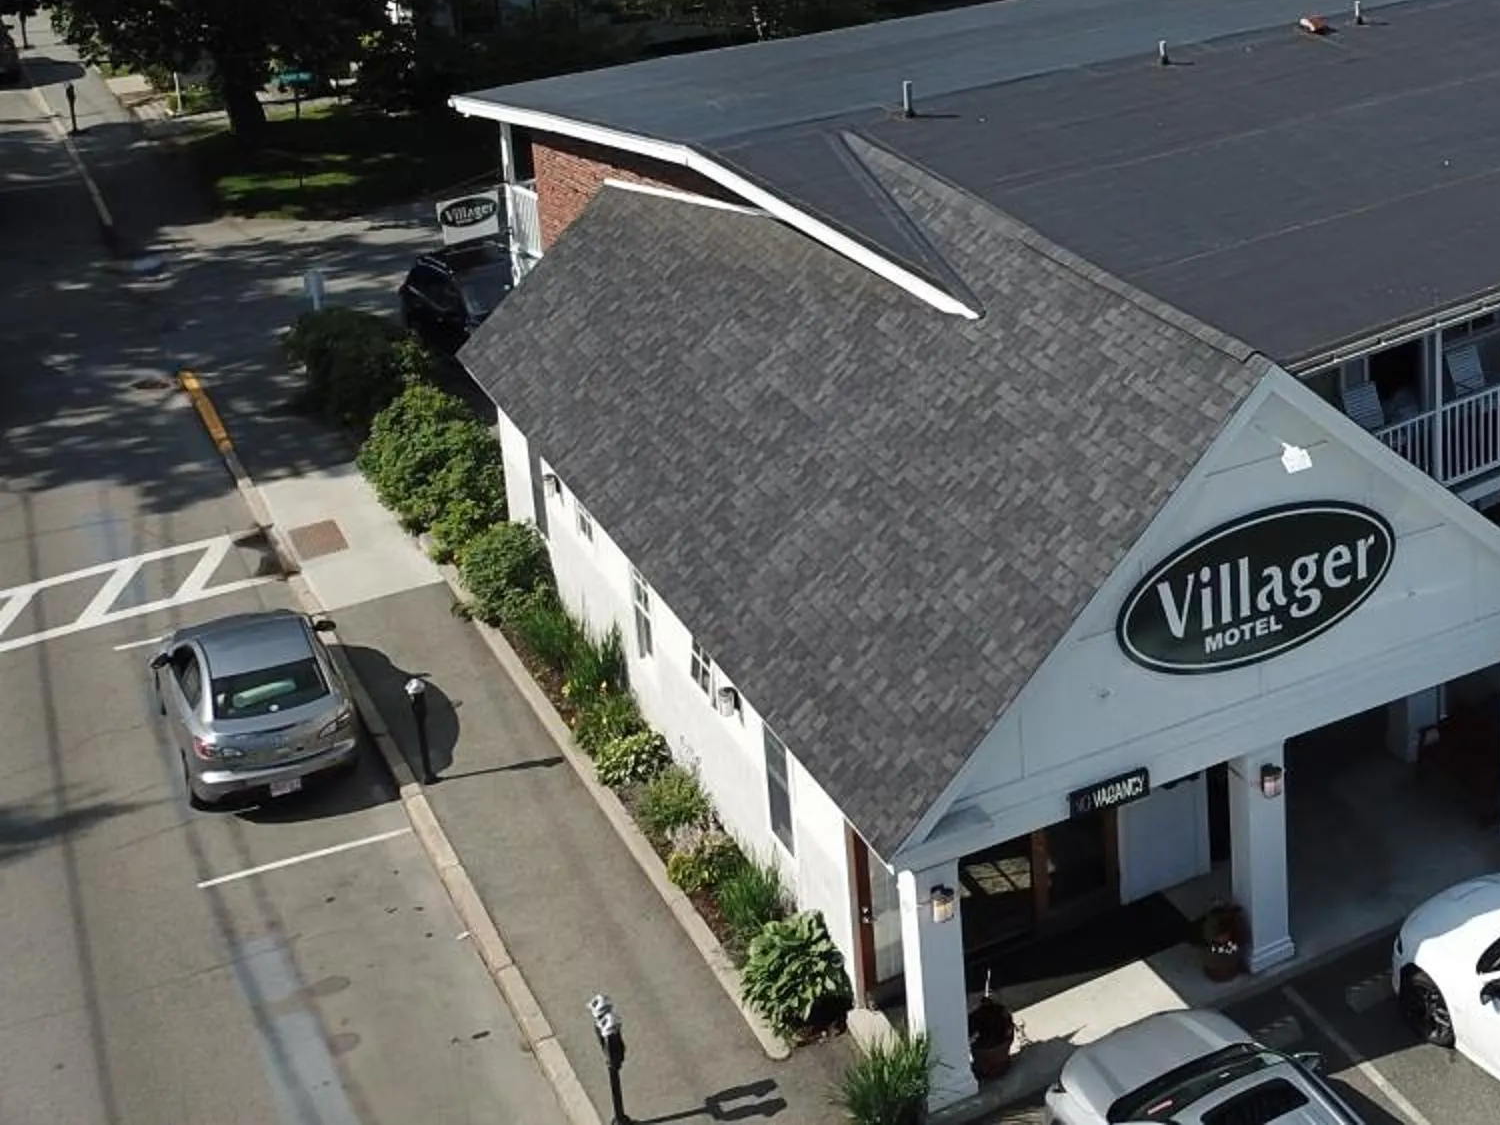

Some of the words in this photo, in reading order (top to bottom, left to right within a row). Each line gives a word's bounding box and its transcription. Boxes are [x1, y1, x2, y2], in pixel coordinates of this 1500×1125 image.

[1156, 535, 1376, 639] Villager
[1204, 614, 1283, 654] MOTEL
[1092, 774, 1146, 808] VACANCY
